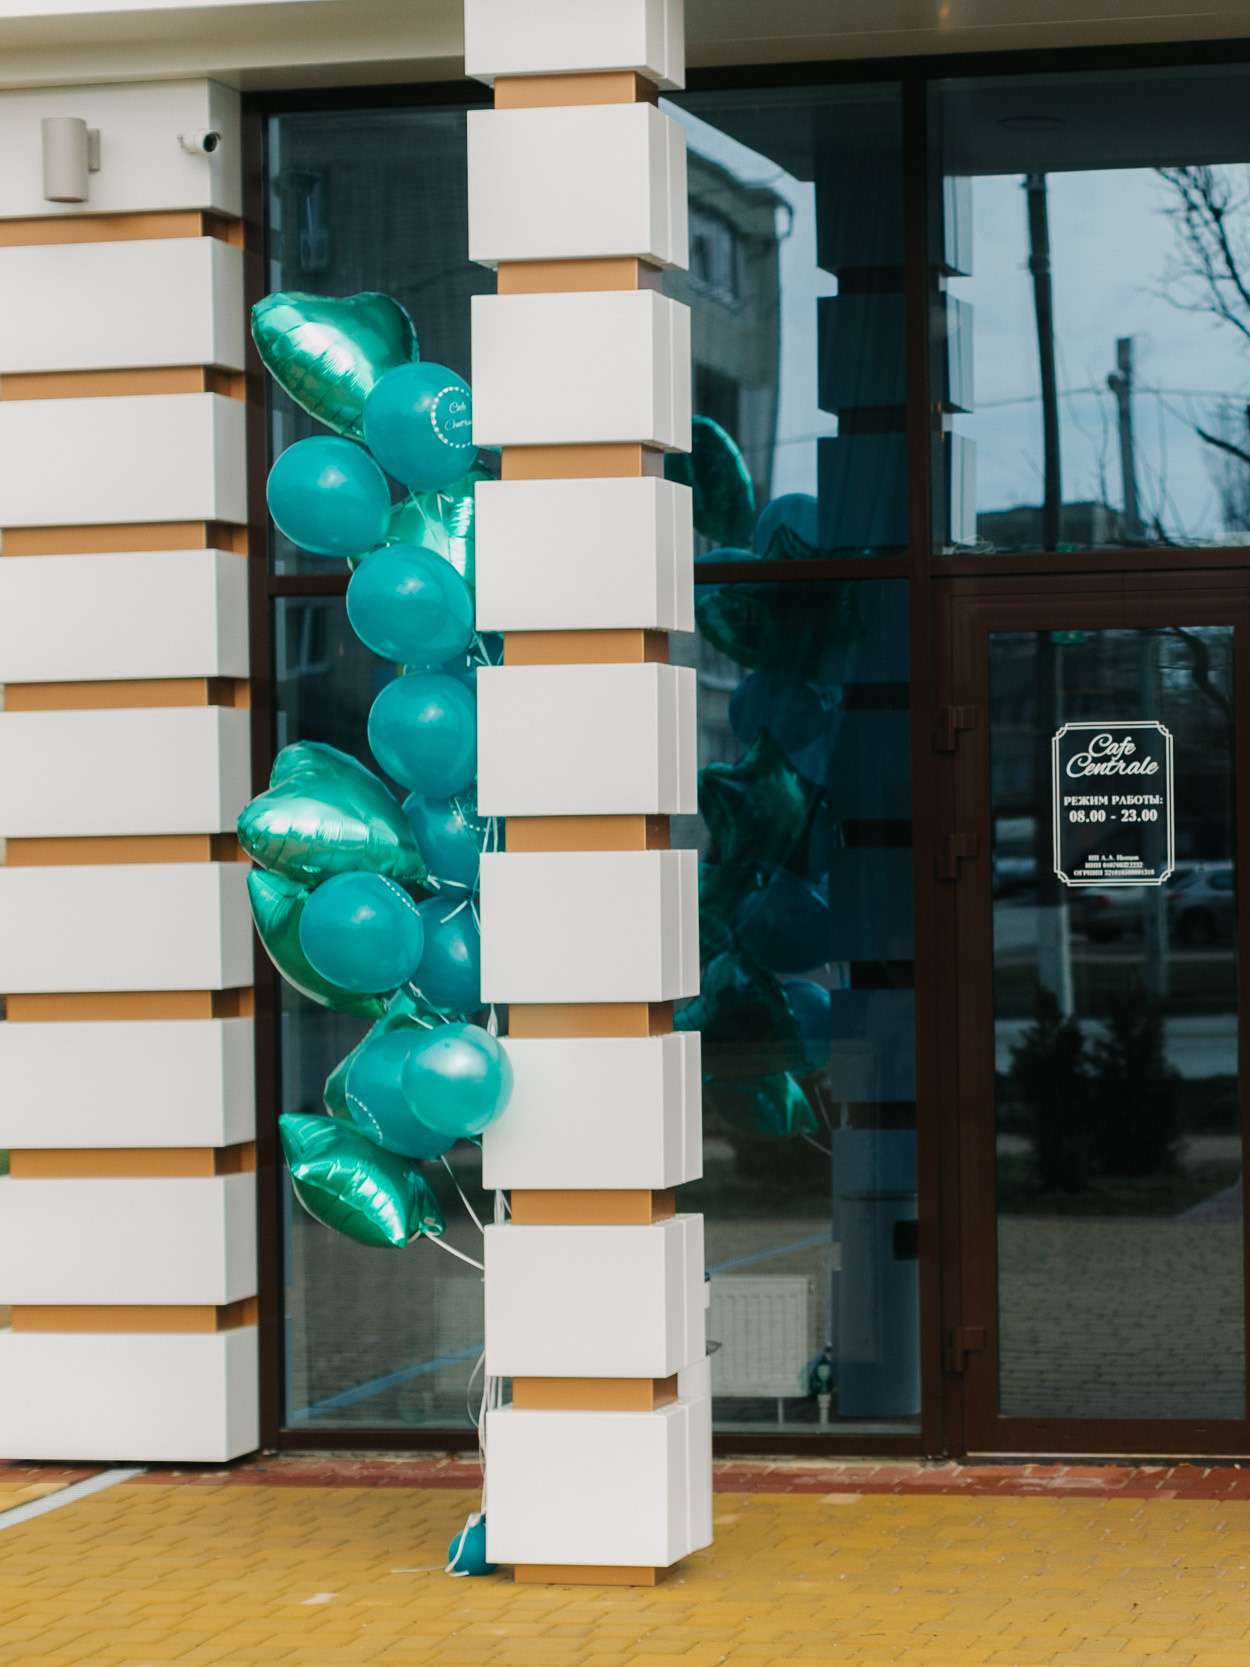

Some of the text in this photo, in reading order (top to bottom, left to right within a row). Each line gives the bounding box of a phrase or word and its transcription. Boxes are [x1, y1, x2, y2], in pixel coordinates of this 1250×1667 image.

[1088, 733, 1137, 761] Cafe
[1066, 752, 1159, 778] Centrale
[1063, 795, 1164, 806] РЕЖИМ РАБОТЫ:
[1069, 810, 1106, 823] 08.00
[1120, 809, 1158, 822] 23.00
